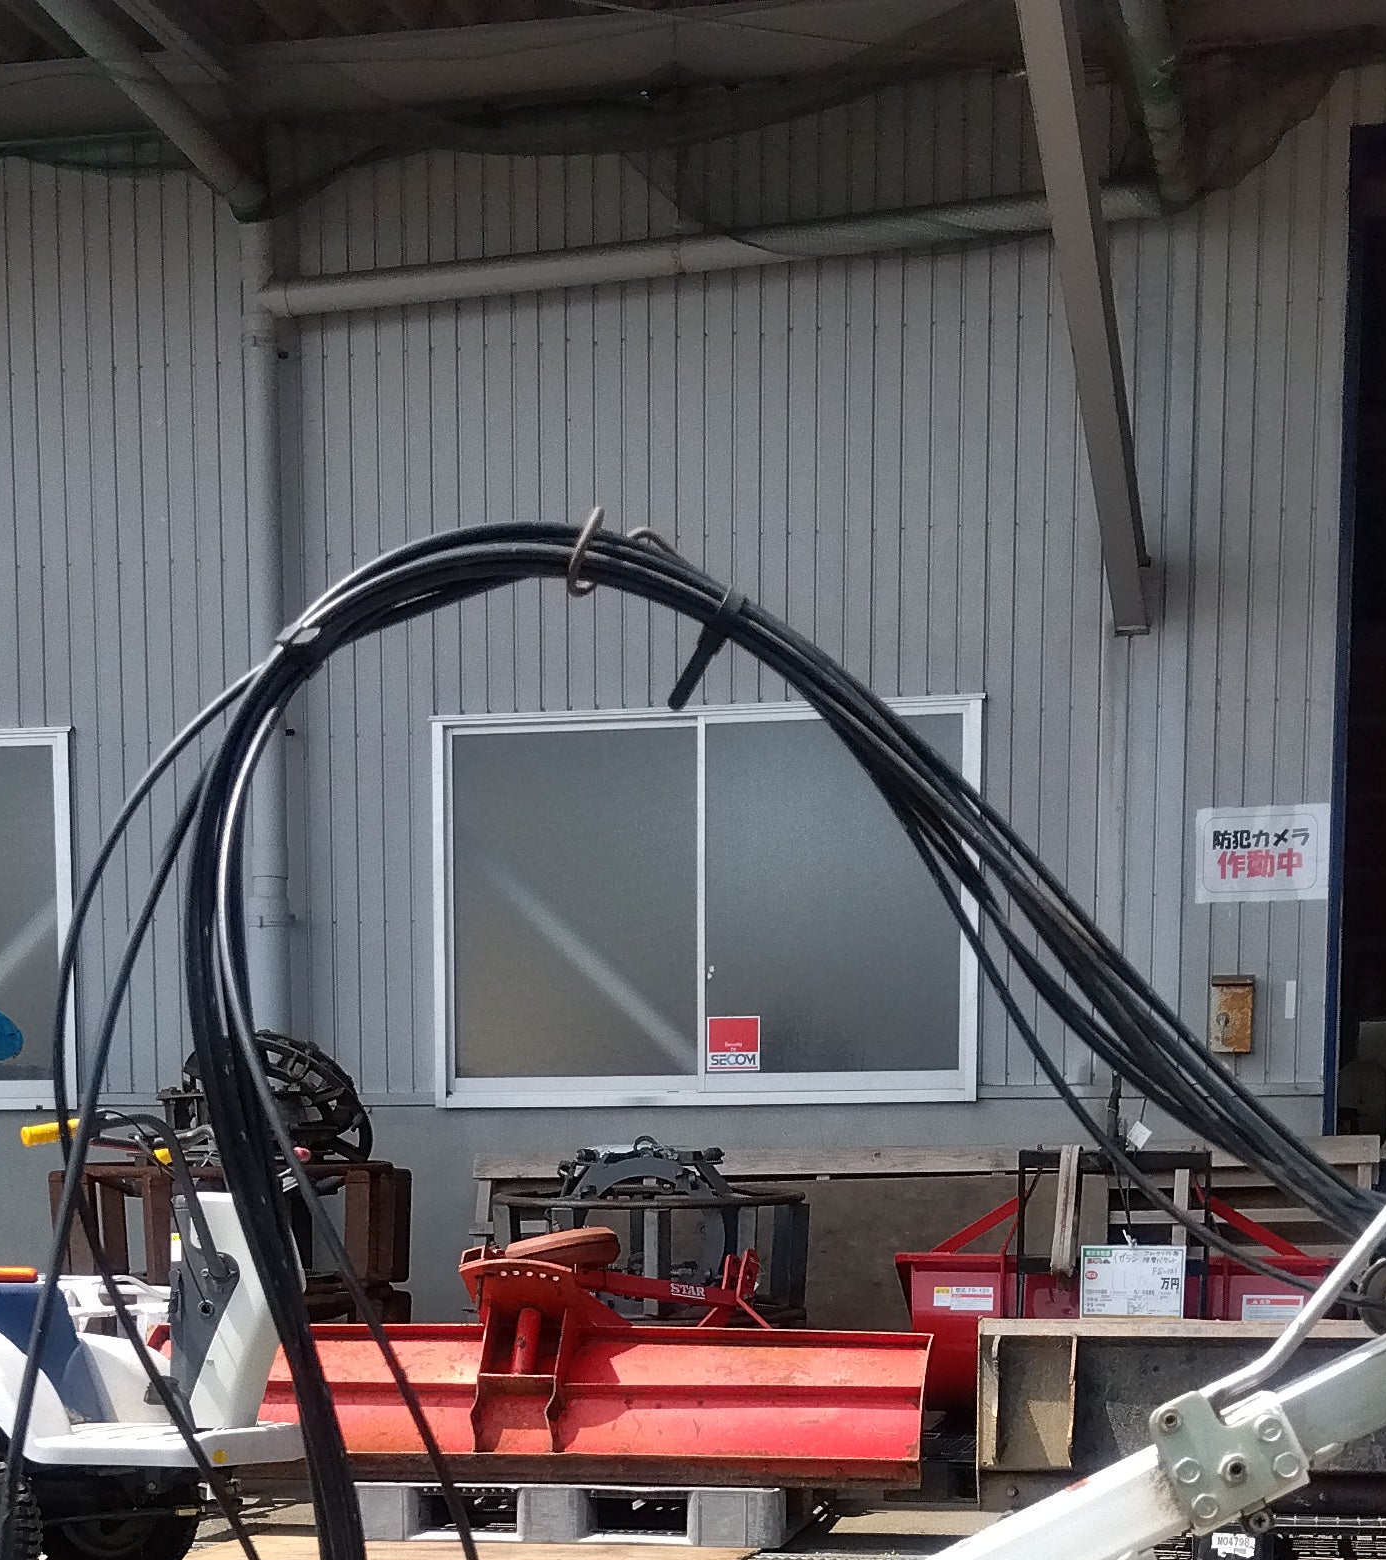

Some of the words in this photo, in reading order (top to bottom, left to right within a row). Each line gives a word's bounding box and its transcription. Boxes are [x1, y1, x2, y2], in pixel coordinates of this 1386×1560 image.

[1212, 827, 1310, 850] 防犯カメラ
[1217, 847, 1303, 880] 作動中
[710, 1053, 756, 1066] SECOM
[670, 1283, 706, 1297] STAR
[1160, 1277, 1180, 1290] 万円
